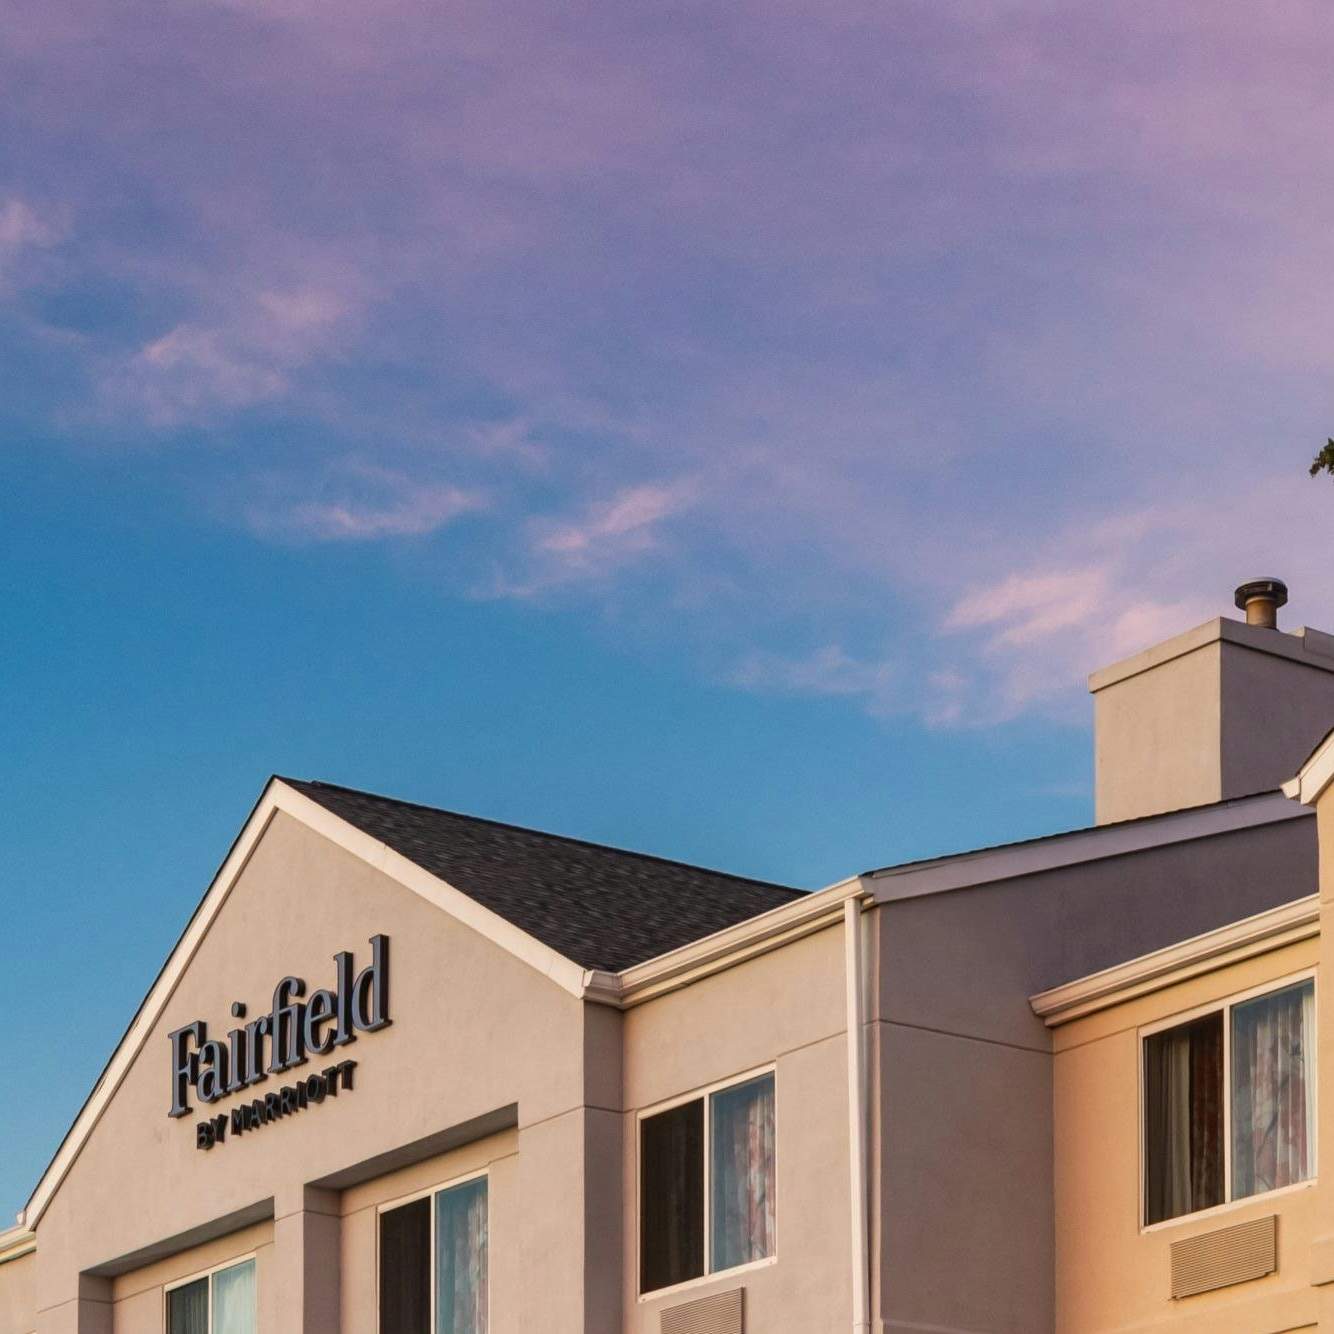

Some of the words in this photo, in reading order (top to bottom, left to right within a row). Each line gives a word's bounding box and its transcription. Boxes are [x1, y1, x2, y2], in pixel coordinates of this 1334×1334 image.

[168, 934, 393, 1118] Fairfield
[196, 1114, 229, 1150] BY
[231, 1060, 357, 1136] MARRIOTT
